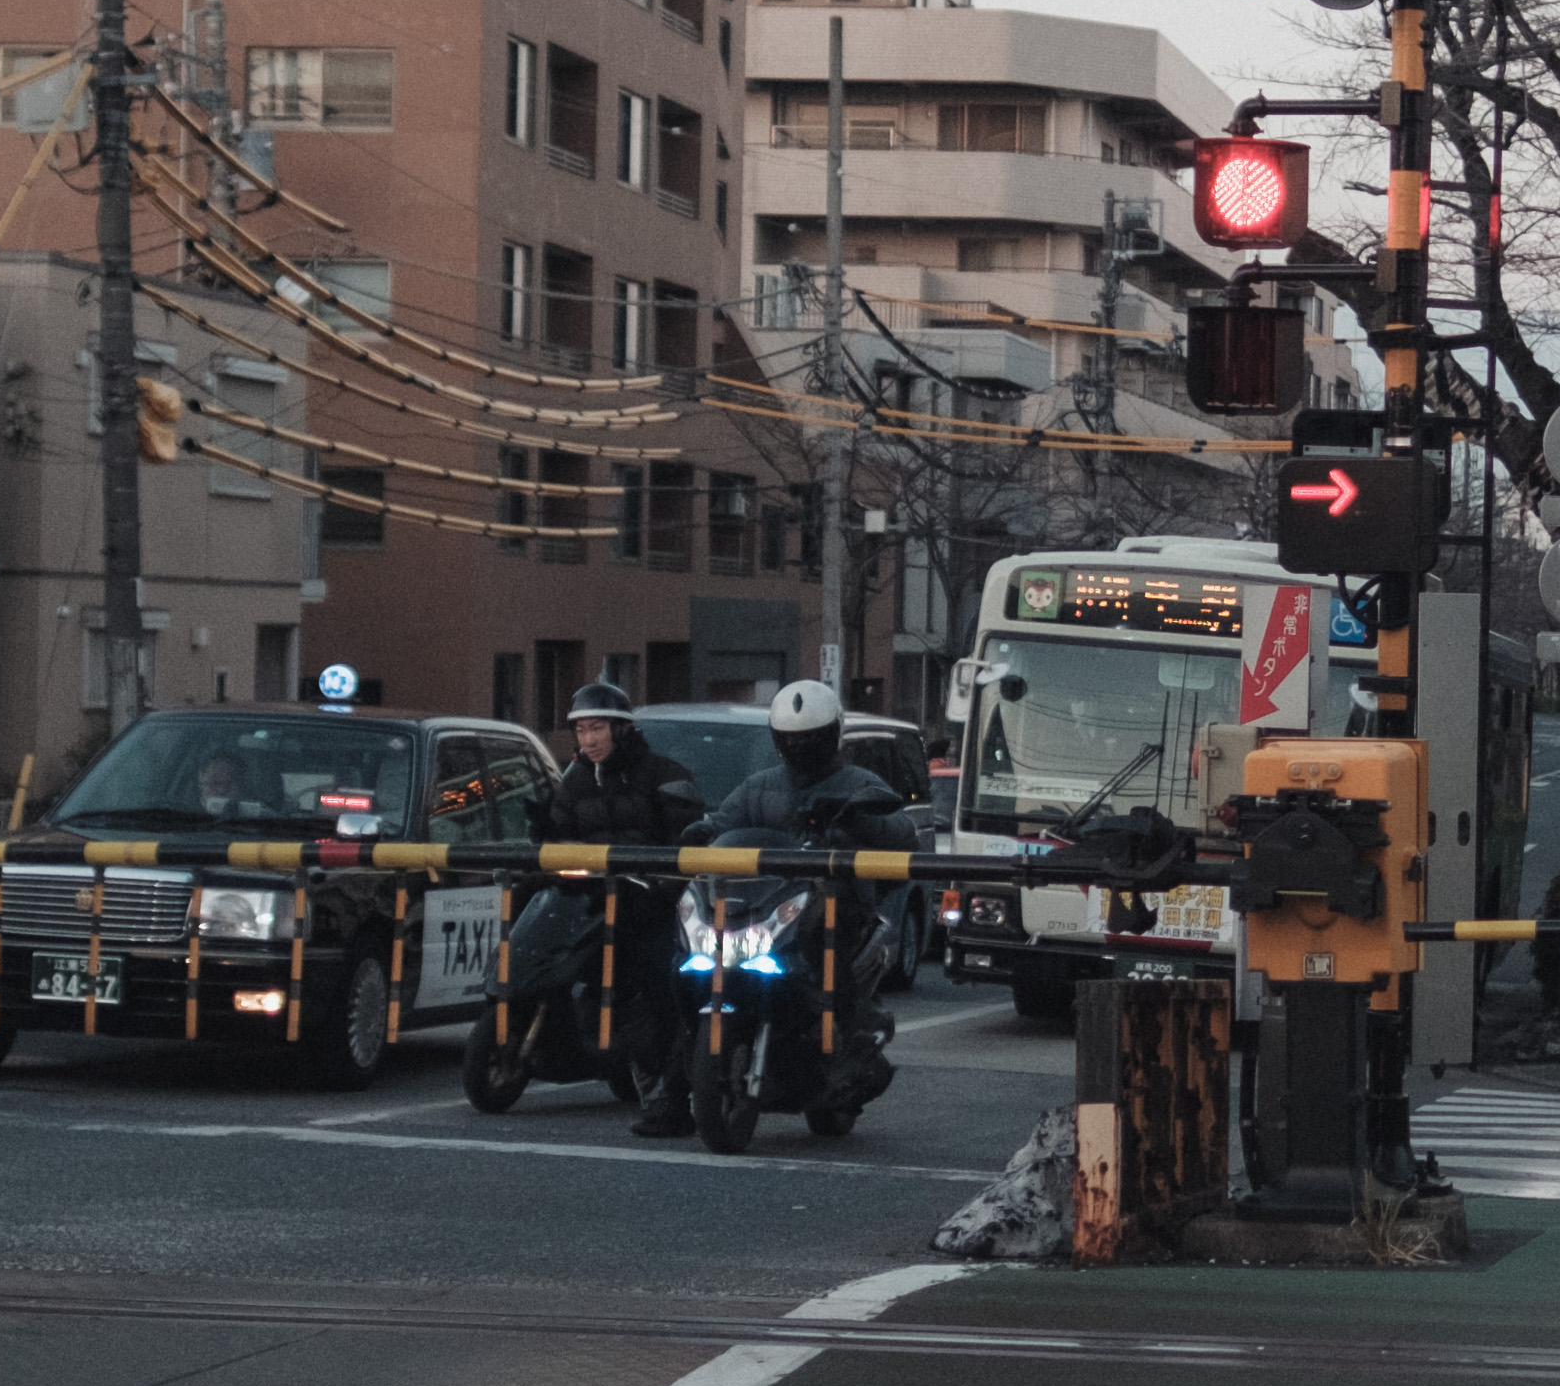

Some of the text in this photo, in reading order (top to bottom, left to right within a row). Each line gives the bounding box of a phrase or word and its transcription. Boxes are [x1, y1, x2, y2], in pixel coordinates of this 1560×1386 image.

[1254, 592, 1308, 697] 非常ボタン
[442, 918, 493, 976] TAXI
[1153, 963, 1172, 973] 200
